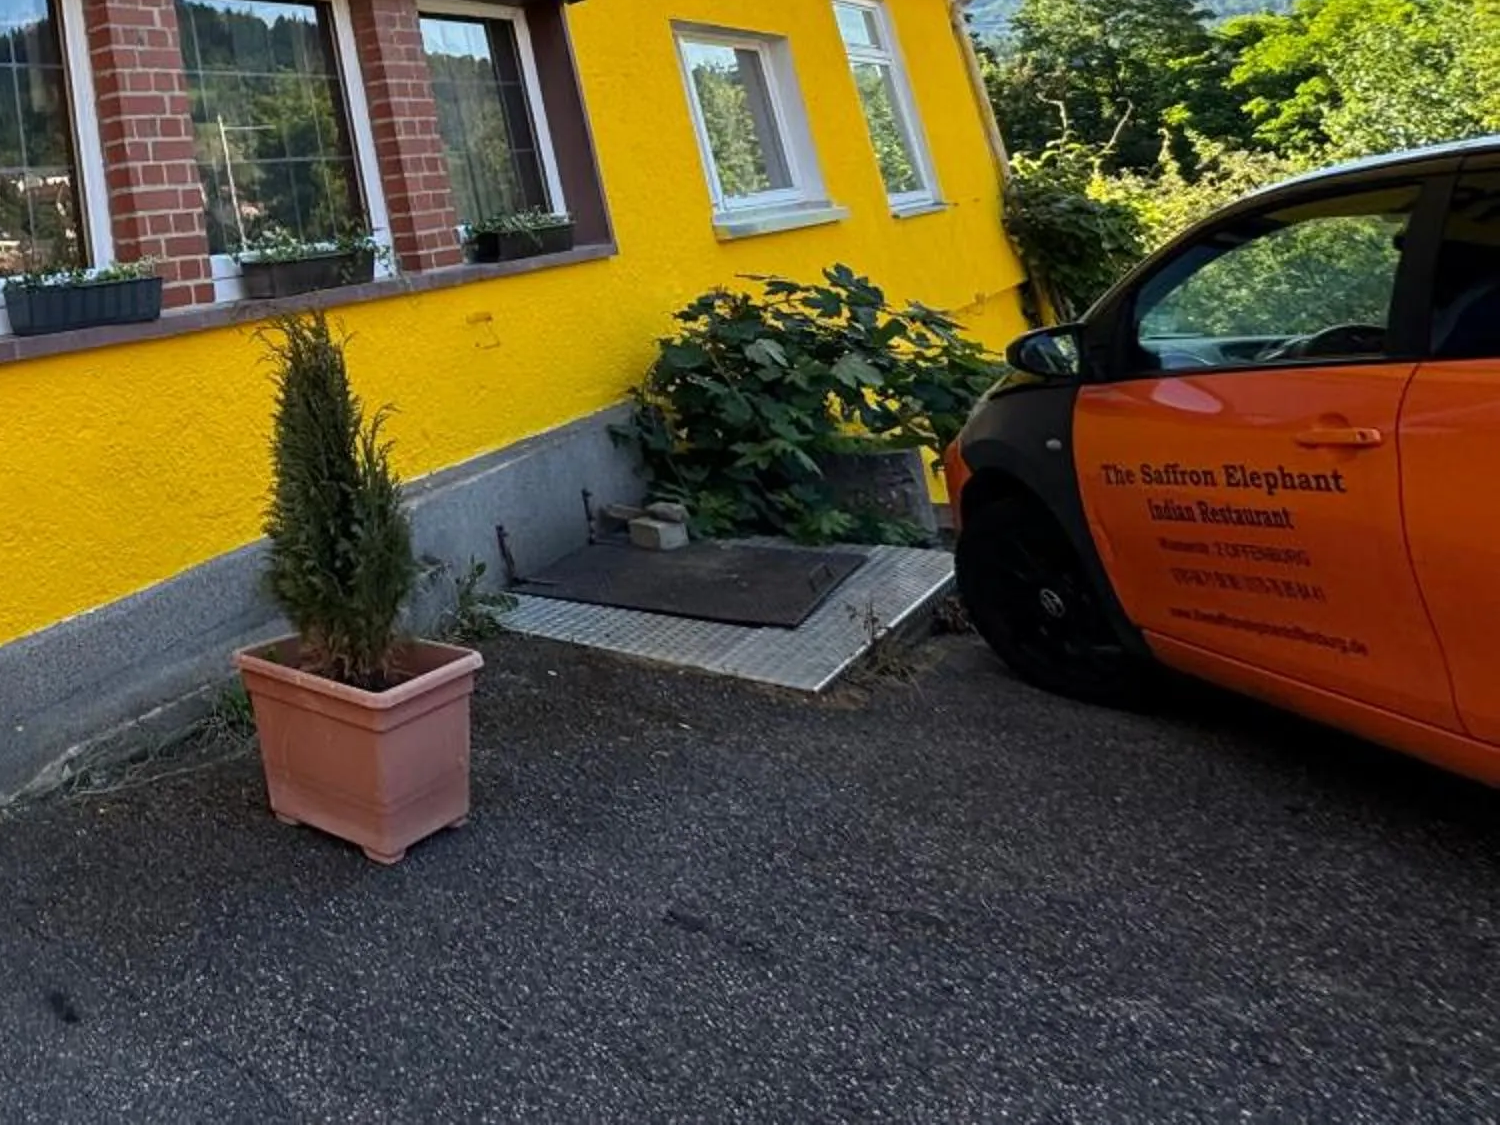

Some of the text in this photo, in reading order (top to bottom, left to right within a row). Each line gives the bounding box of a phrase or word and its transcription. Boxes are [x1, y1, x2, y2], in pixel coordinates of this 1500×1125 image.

[1101, 463, 1348, 495] The Saffron Elephant
[1148, 498, 1295, 529] Indian Restaurant
